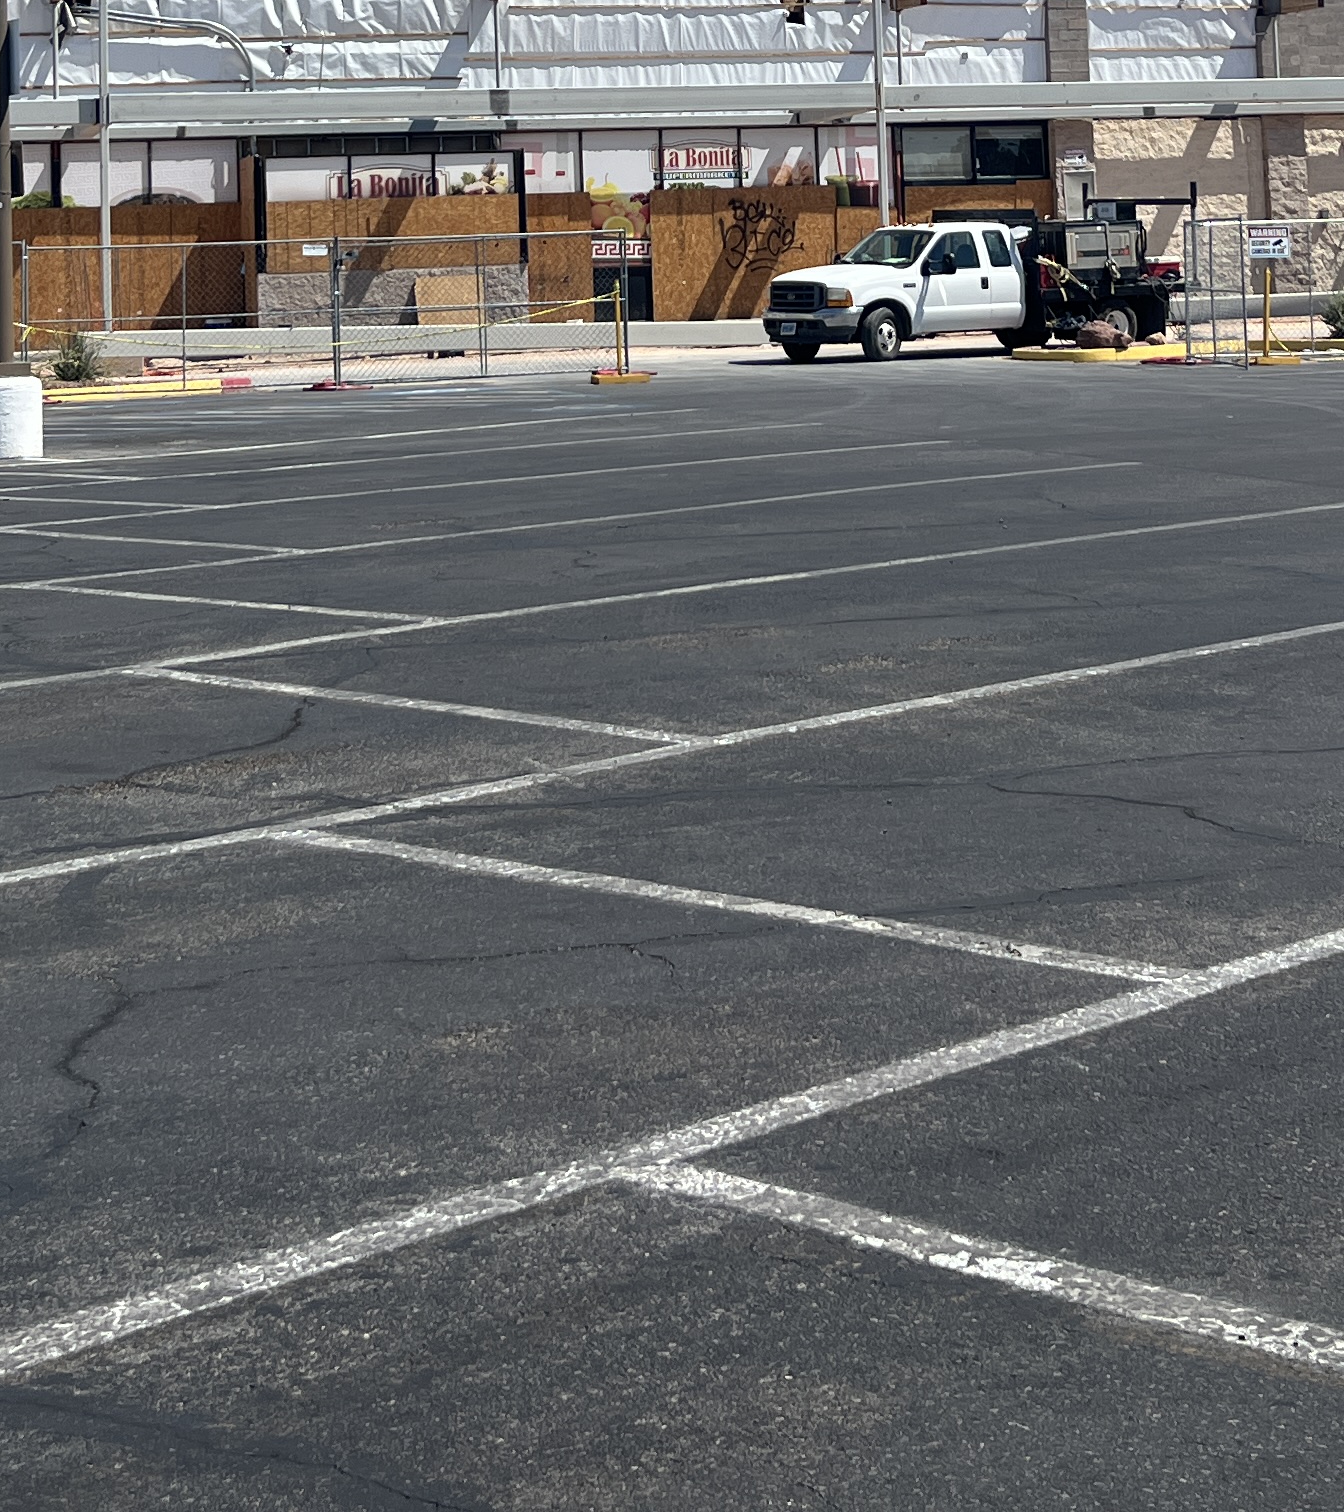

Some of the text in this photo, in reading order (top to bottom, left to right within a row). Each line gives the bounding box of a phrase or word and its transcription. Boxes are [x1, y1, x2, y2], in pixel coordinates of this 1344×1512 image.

[685, 146, 743, 168] Bonita
[336, 172, 440, 199] La Bonita
[1249, 228, 1287, 237] WARNING
